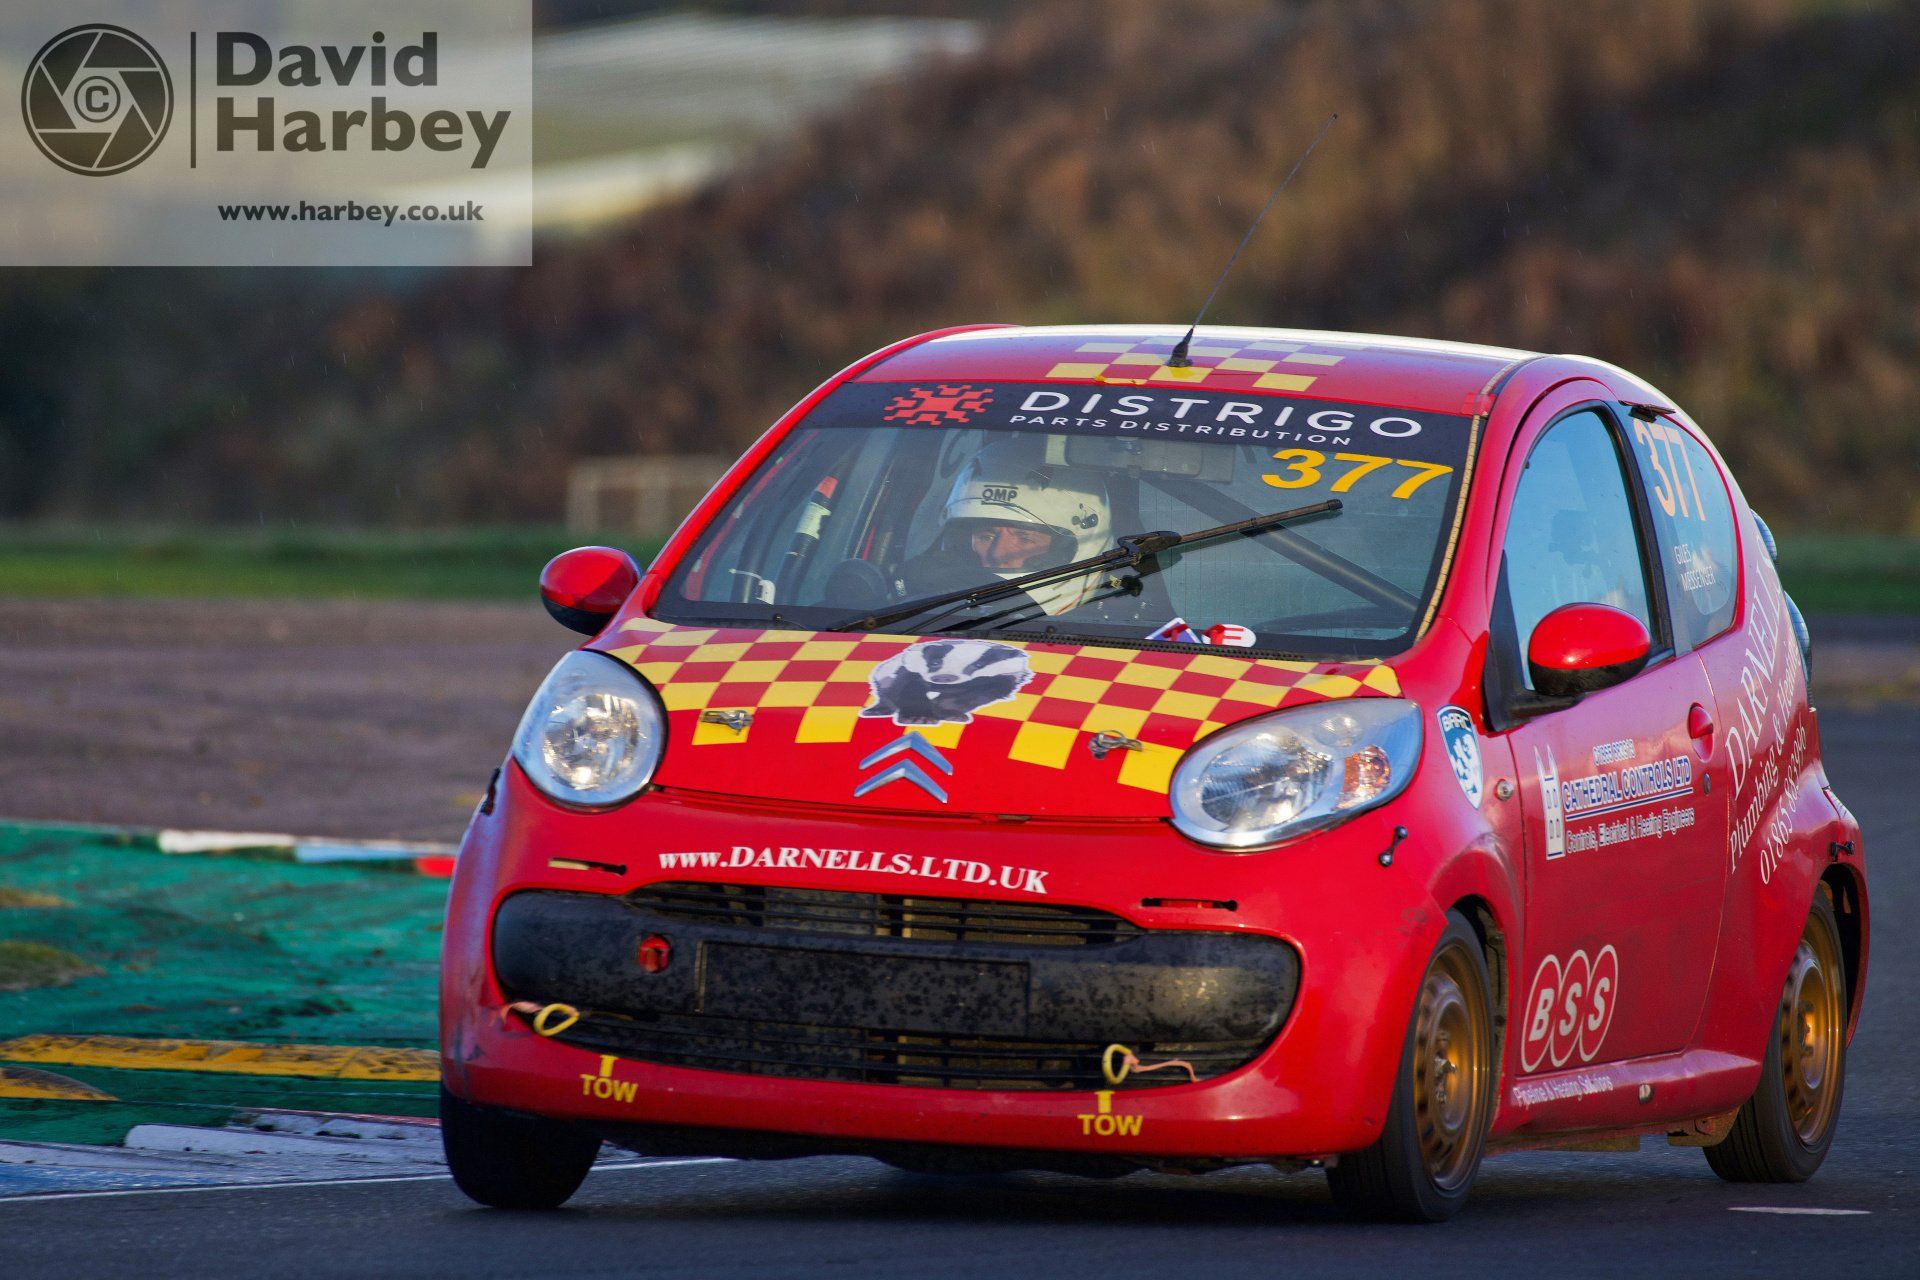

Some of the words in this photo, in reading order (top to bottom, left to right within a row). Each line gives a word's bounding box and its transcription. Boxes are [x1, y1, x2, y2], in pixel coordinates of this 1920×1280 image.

[1009, 415, 1107, 428] PARTS
[1119, 420, 1351, 446] DISTRIBUTION
[1019, 391, 1422, 438] DISTRIGO
[1261, 448, 1454, 500] 377
[1633, 417, 1707, 522] 377
[982, 488, 1018, 502] OMP
[1441, 712, 1473, 733] BARC
[1562, 771, 1622, 812] CATHEDRAL
[1621, 758, 1674, 800] CONTROLS
[1672, 755, 1692, 787] LTD
[1730, 744, 1779, 875] Plumbing
[1773, 713, 1786, 757] &
[1637, 811, 1663, 839] Heating
[1662, 807, 1695, 835] Engineers
[1760, 795, 1793, 885] 01865
[658, 846, 1049, 894] www.DARNELLS.LTD.UK
[1528, 976, 1611, 1042] BSS
[580, 1073, 639, 1104] TOW
[1077, 1113, 1144, 1137] TOW
